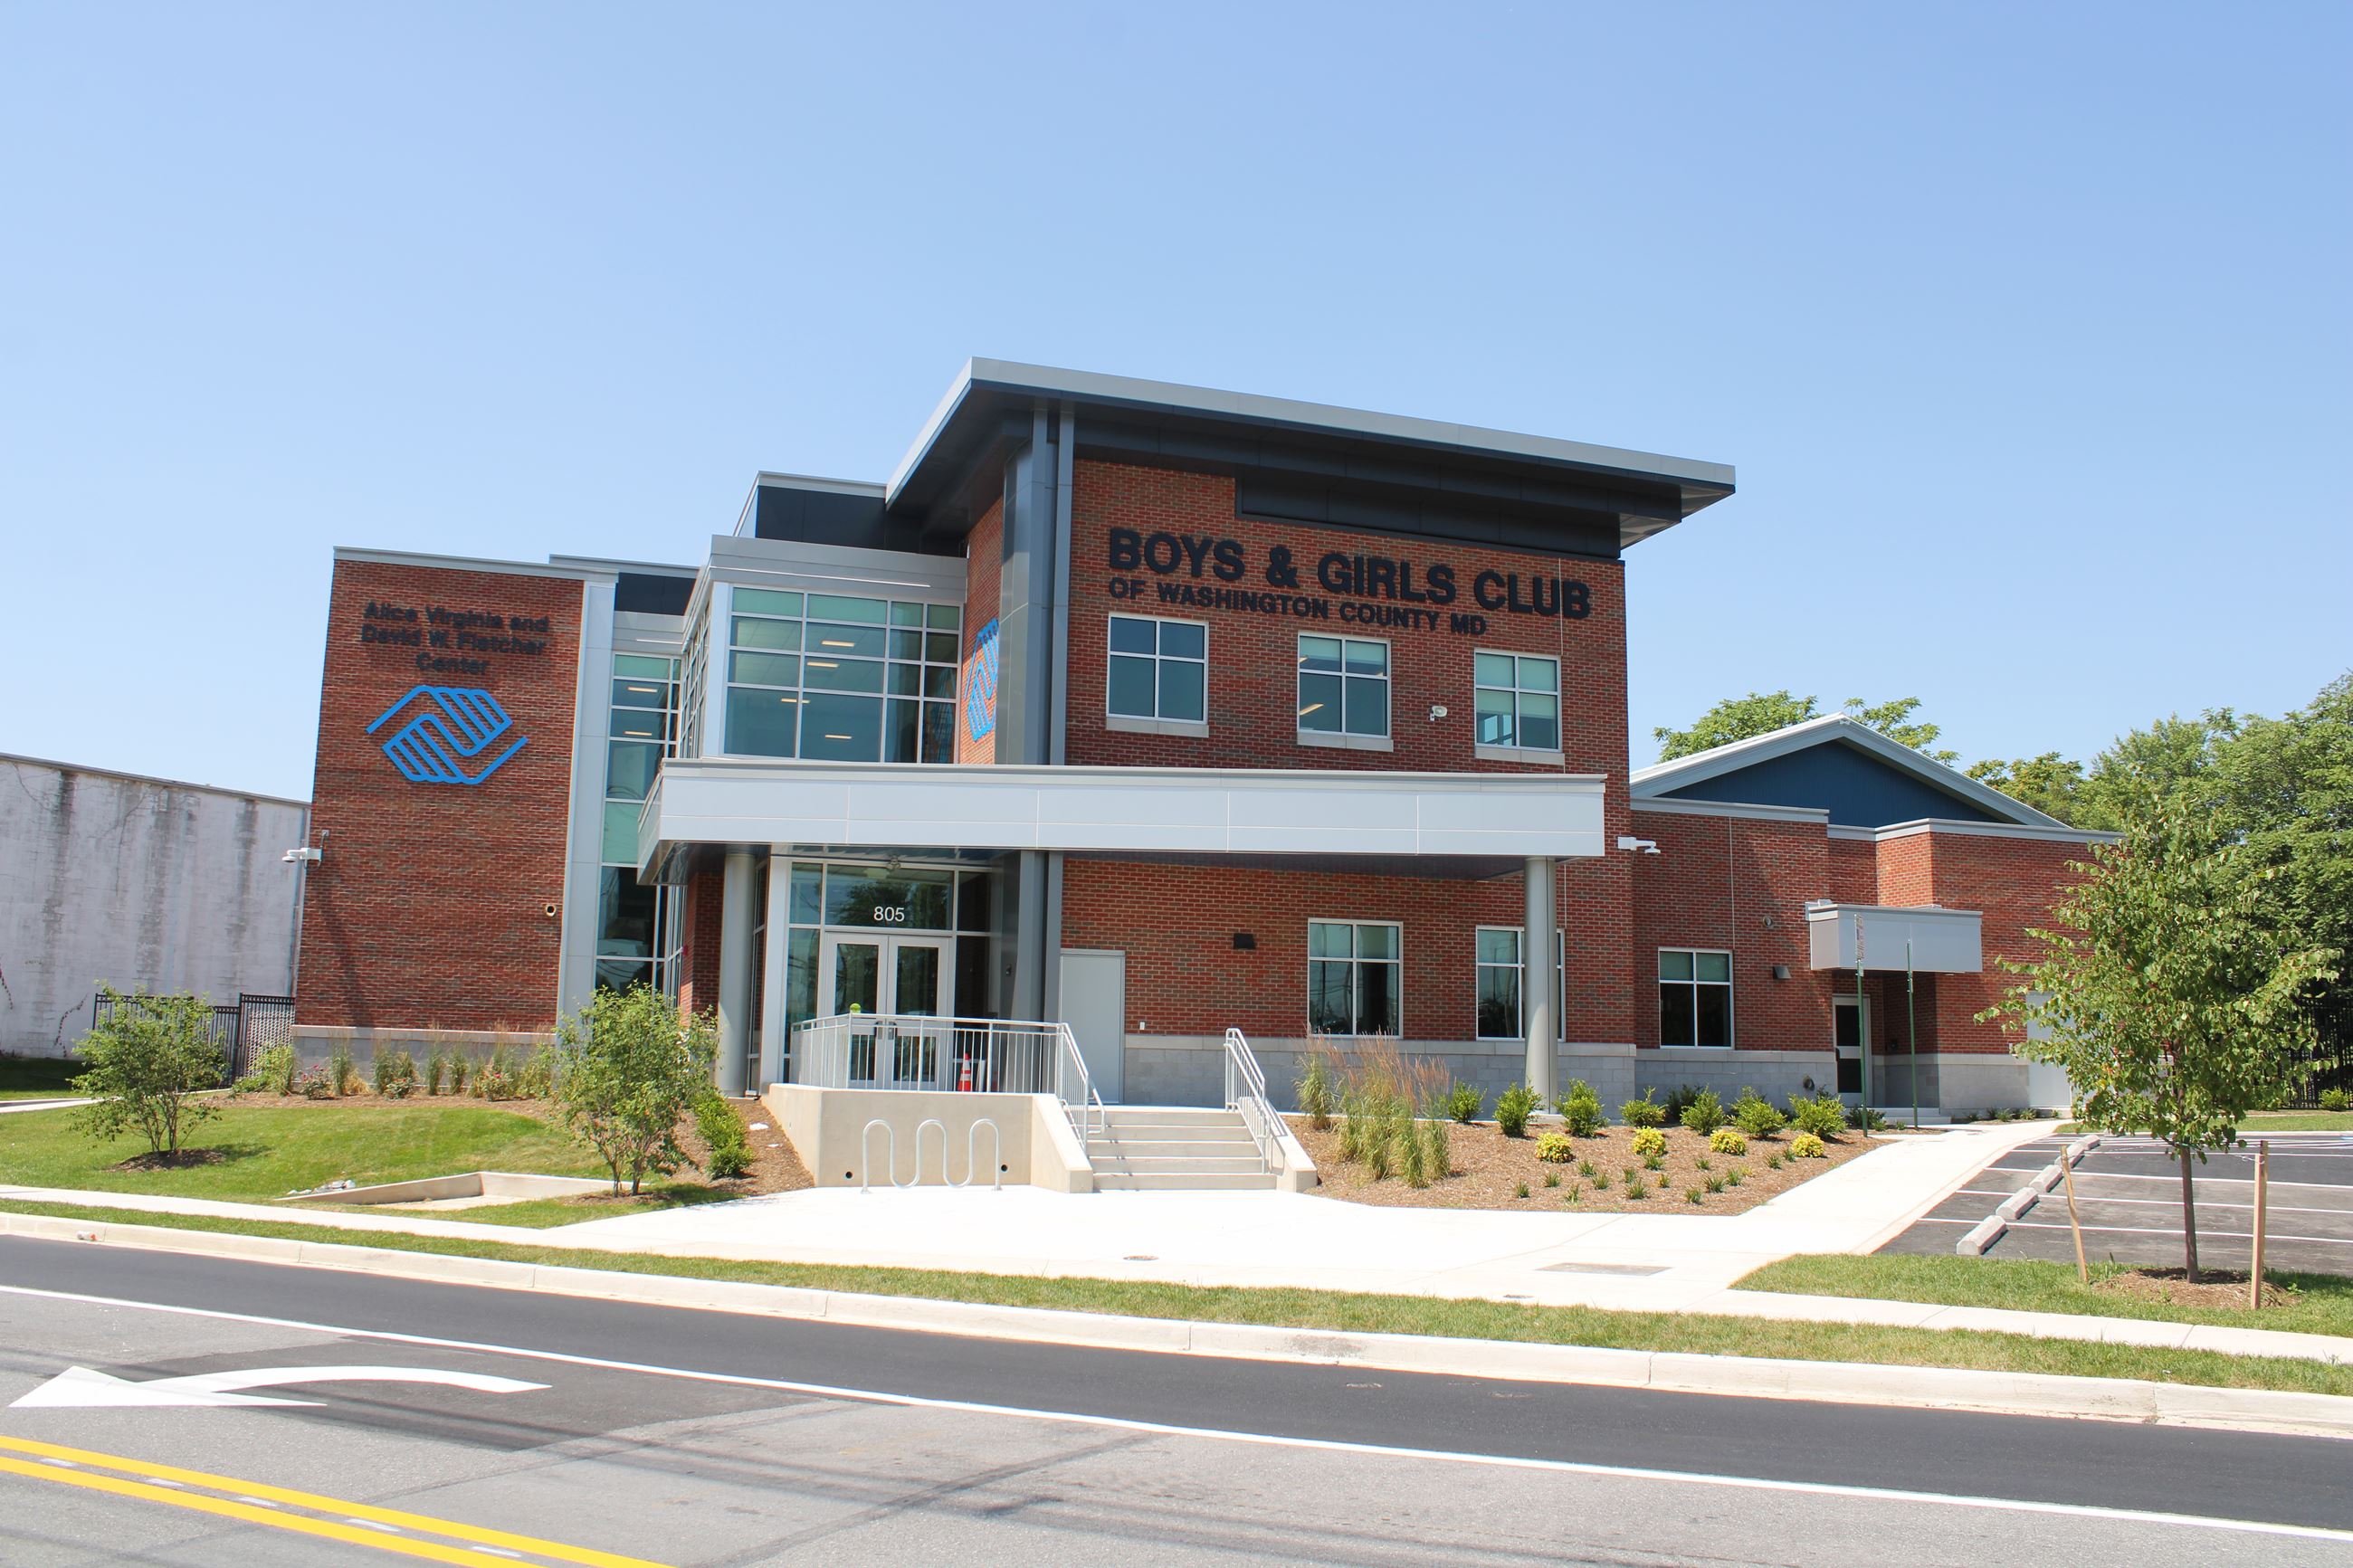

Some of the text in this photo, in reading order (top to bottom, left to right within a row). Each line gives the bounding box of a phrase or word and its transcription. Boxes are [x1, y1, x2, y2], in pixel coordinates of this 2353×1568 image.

[1110, 528, 1591, 620] BOYS & GIRLS CLUB
[364, 601, 550, 632] Alice Virginia and
[1109, 576, 1487, 635] OF WASHINGTON COUNTY MD
[361, 624, 422, 647] David
[457, 632, 548, 655] Fletcher
[415, 651, 490, 675] Center
[873, 906, 905, 922] 805
